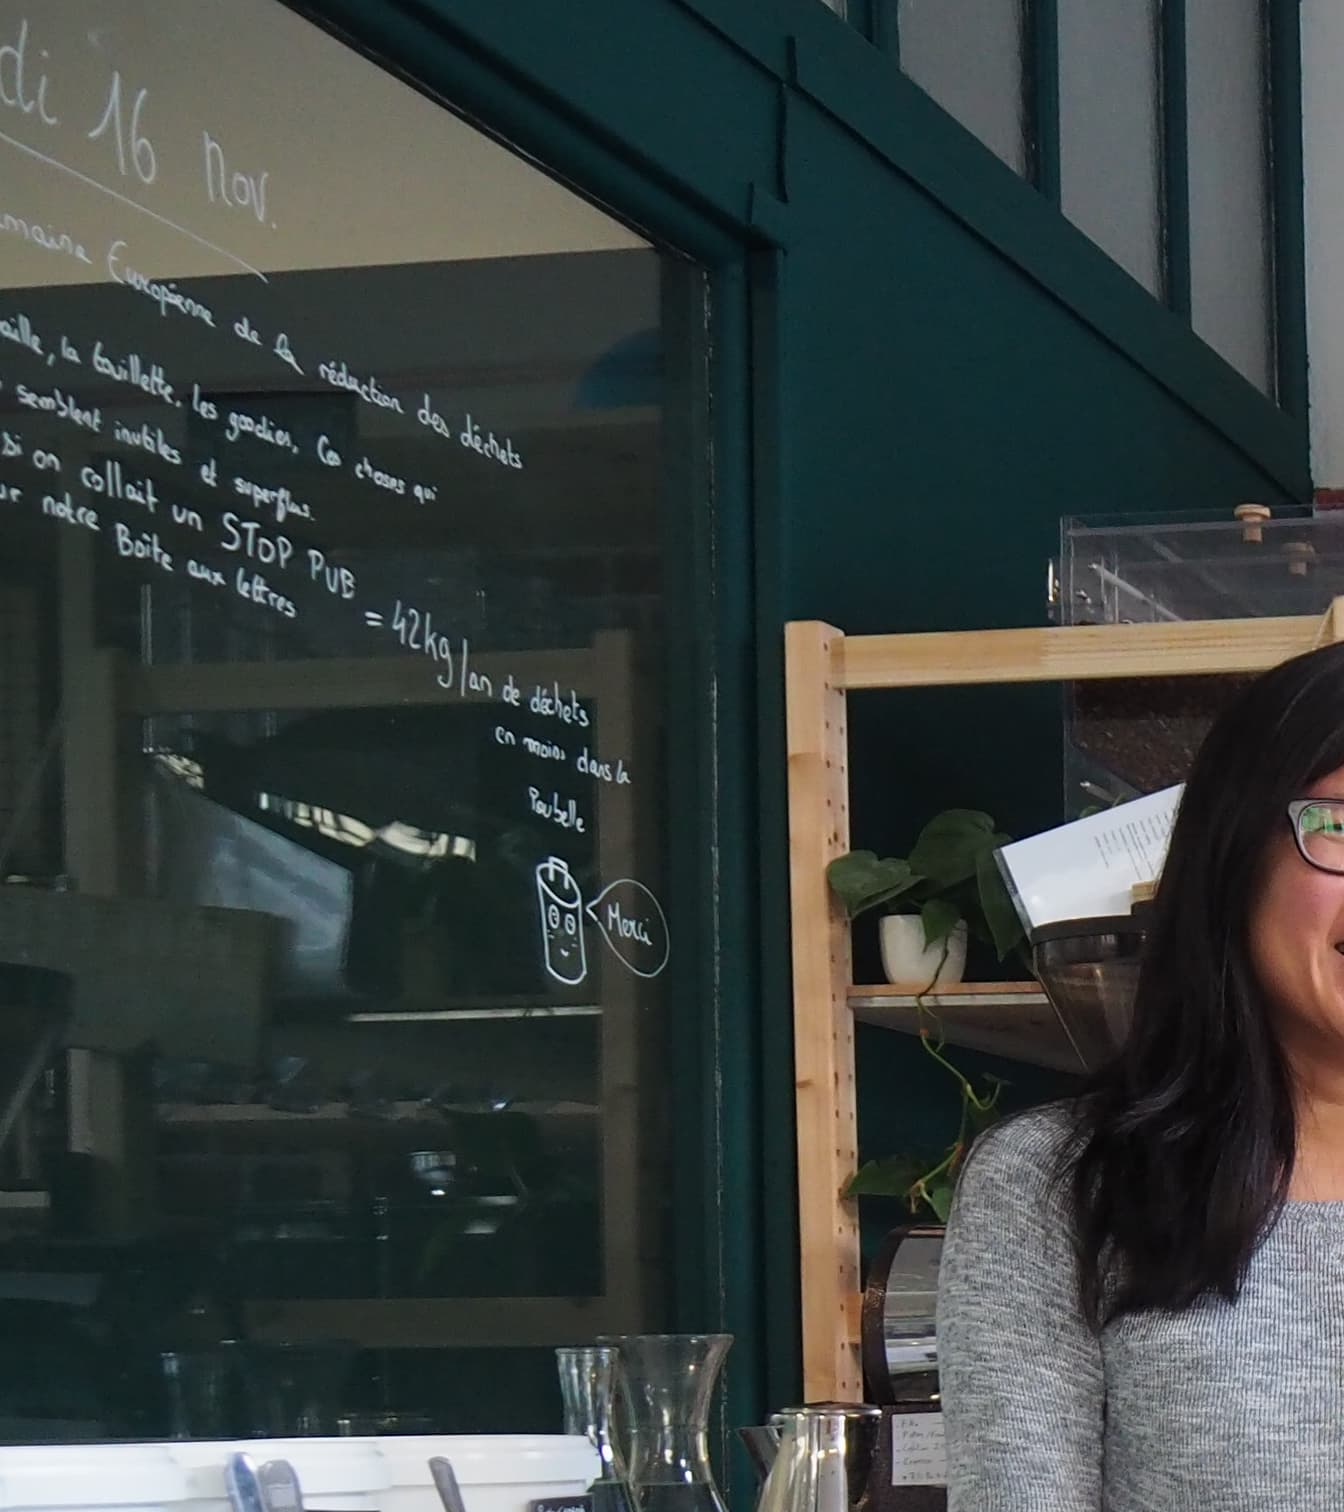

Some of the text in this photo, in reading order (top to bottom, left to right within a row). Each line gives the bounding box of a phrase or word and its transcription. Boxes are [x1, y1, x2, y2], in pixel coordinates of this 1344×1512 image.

[88, 70, 156, 184] 16
[16, 384, 102, 432] semblent
[114, 420, 182, 465] inutiles
[201, 459, 217, 487] et
[61, 336, 81, 364] la
[355, 457, 406, 495] choses
[414, 487, 438, 504] qui
[234, 317, 262, 345] de
[319, 361, 405, 414] réduction
[418, 394, 450, 438] des
[460, 414, 523, 469] déchets
[33, 450, 61, 472] on
[81, 460, 158, 512] collait
[172, 504, 203, 531] un
[221, 512, 292, 568] STOP
[308, 550, 357, 599] PUB
[503, 674, 520, 707] de
[530, 681, 589, 727] déchets
[42, 493, 101, 531] notre
[115, 522, 174, 571] Boîte
[187, 560, 227, 585] aux
[236, 567, 297, 619] lettres
[495, 726, 631, 784] en moins dans la
[528, 786, 585, 832] Poubelle
[607, 902, 652, 946] Merci
